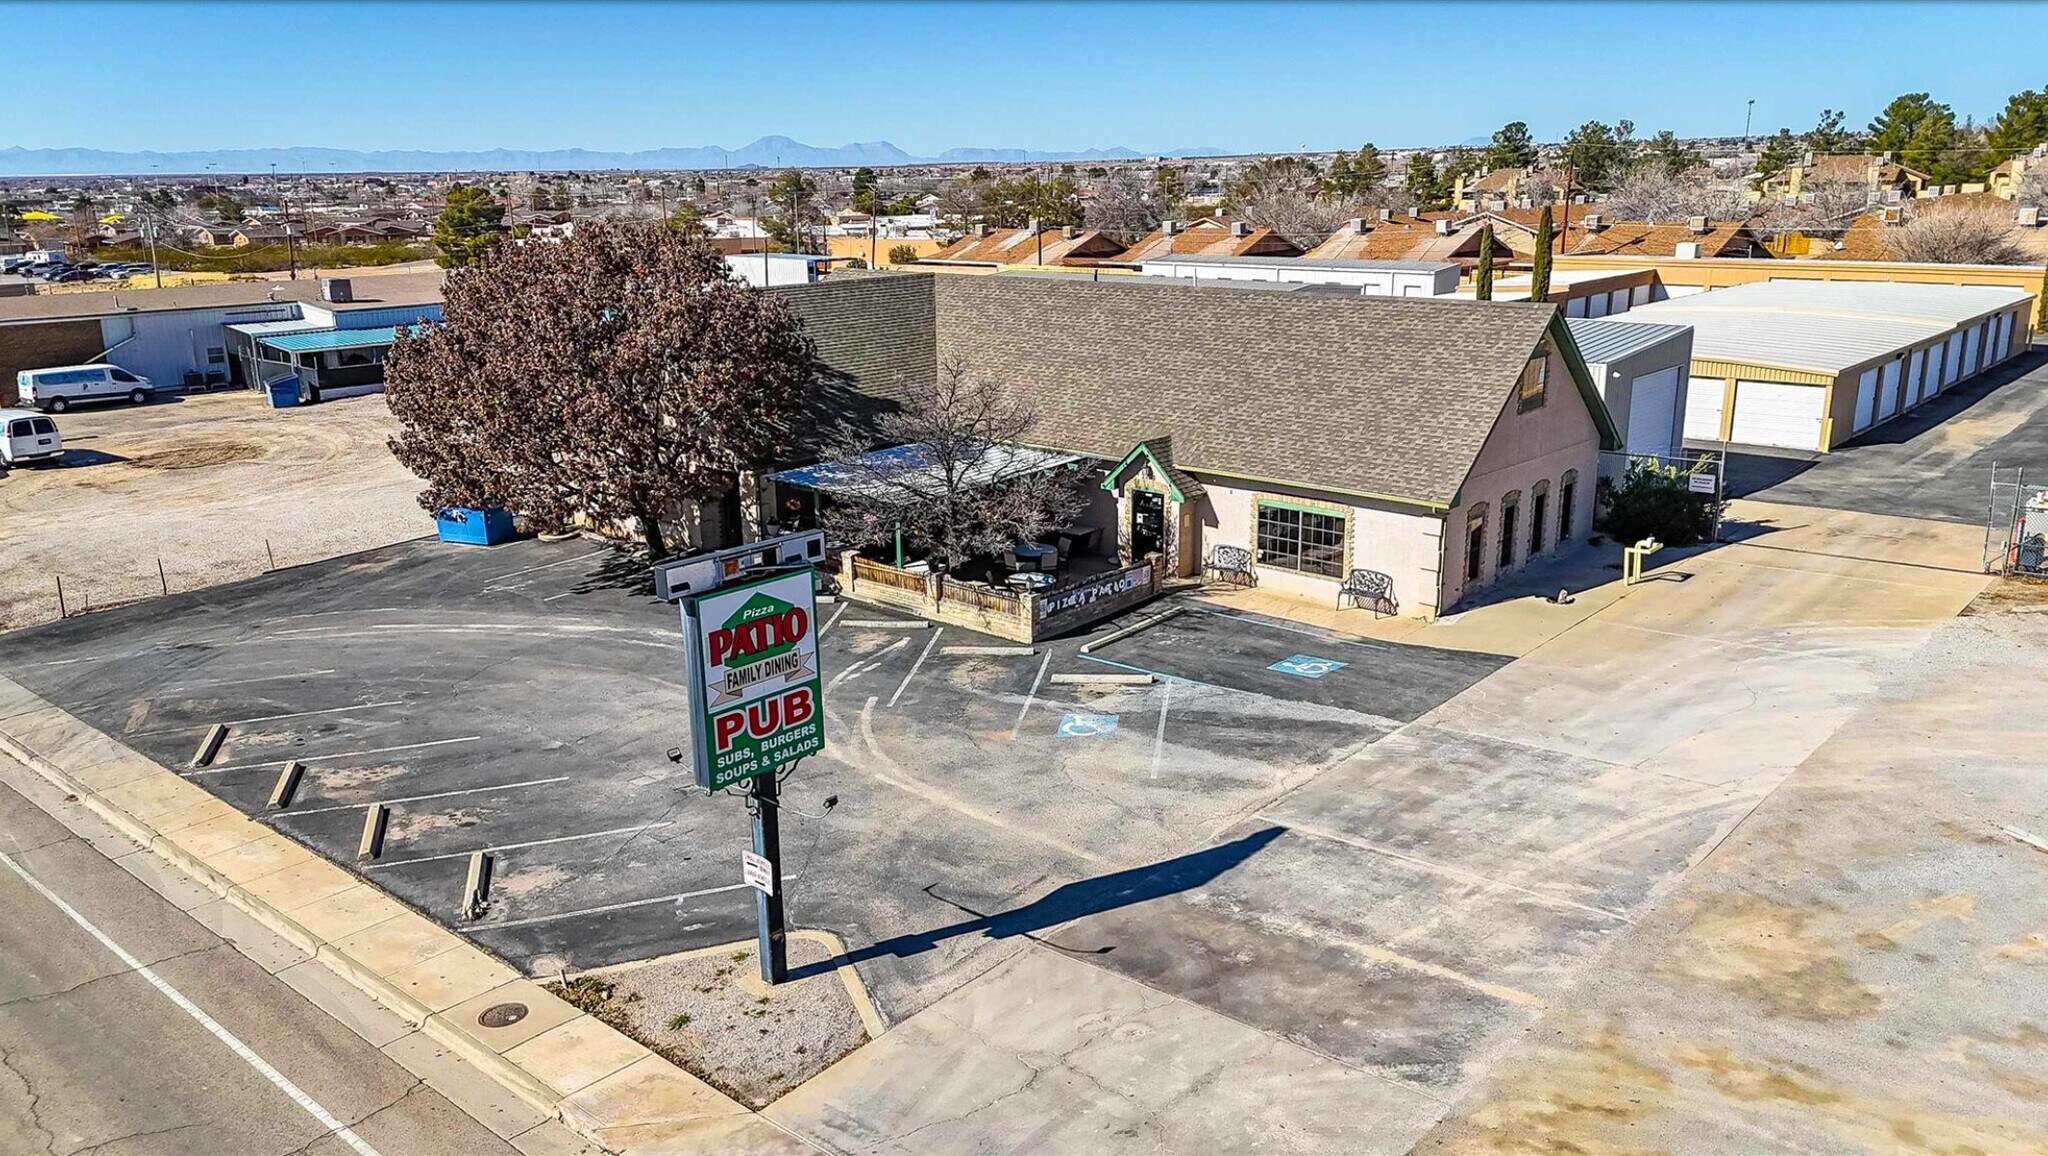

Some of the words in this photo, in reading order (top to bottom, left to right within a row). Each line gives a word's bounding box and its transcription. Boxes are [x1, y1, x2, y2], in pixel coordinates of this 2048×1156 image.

[743, 605, 775, 620] Pizza
[708, 607, 808, 668] PATIO
[726, 662, 763, 690] FAMILY
[764, 652, 799, 678] DINING
[714, 687, 815, 754] PUB
[716, 760, 758, 783] SOUPS
[761, 756, 771, 767] &
[773, 737, 819, 762] SALADS
[717, 747, 754, 768] SUBS,
[761, 723, 816, 752] BURGERS
